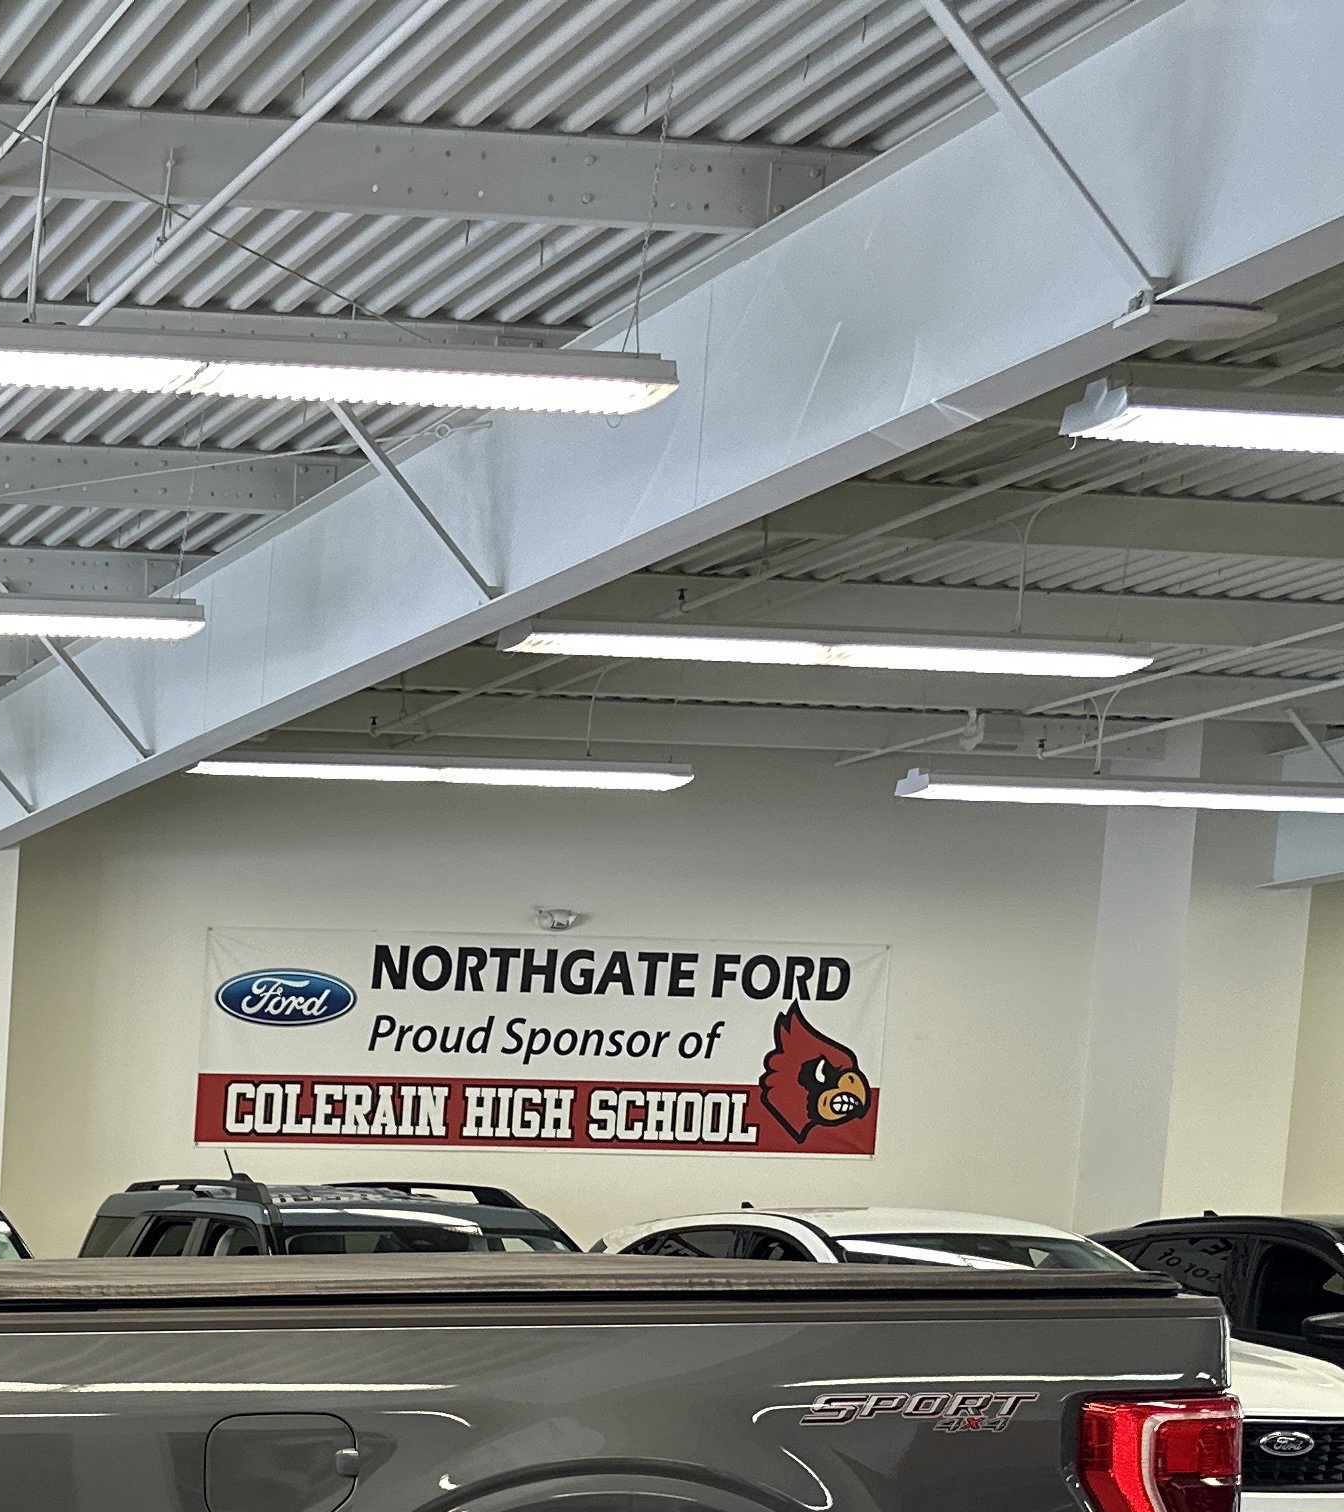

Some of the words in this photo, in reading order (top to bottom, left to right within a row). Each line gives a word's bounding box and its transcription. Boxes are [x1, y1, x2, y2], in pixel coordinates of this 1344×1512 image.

[371, 945, 698, 998] NORTHGATE
[711, 954, 851, 1001] FORD
[240, 976, 330, 1017] Ford
[368, 1014, 494, 1055] Proud
[500, 1017, 670, 1065] Sponsor
[677, 1020, 725, 1061] of
[224, 1083, 449, 1137] COLERAIN
[462, 1085, 575, 1140] HIGH
[587, 1090, 759, 1144] SCHOOL
[799, 1392, 1040, 1426] SPORT
[933, 1416, 1014, 1433] 4x4
